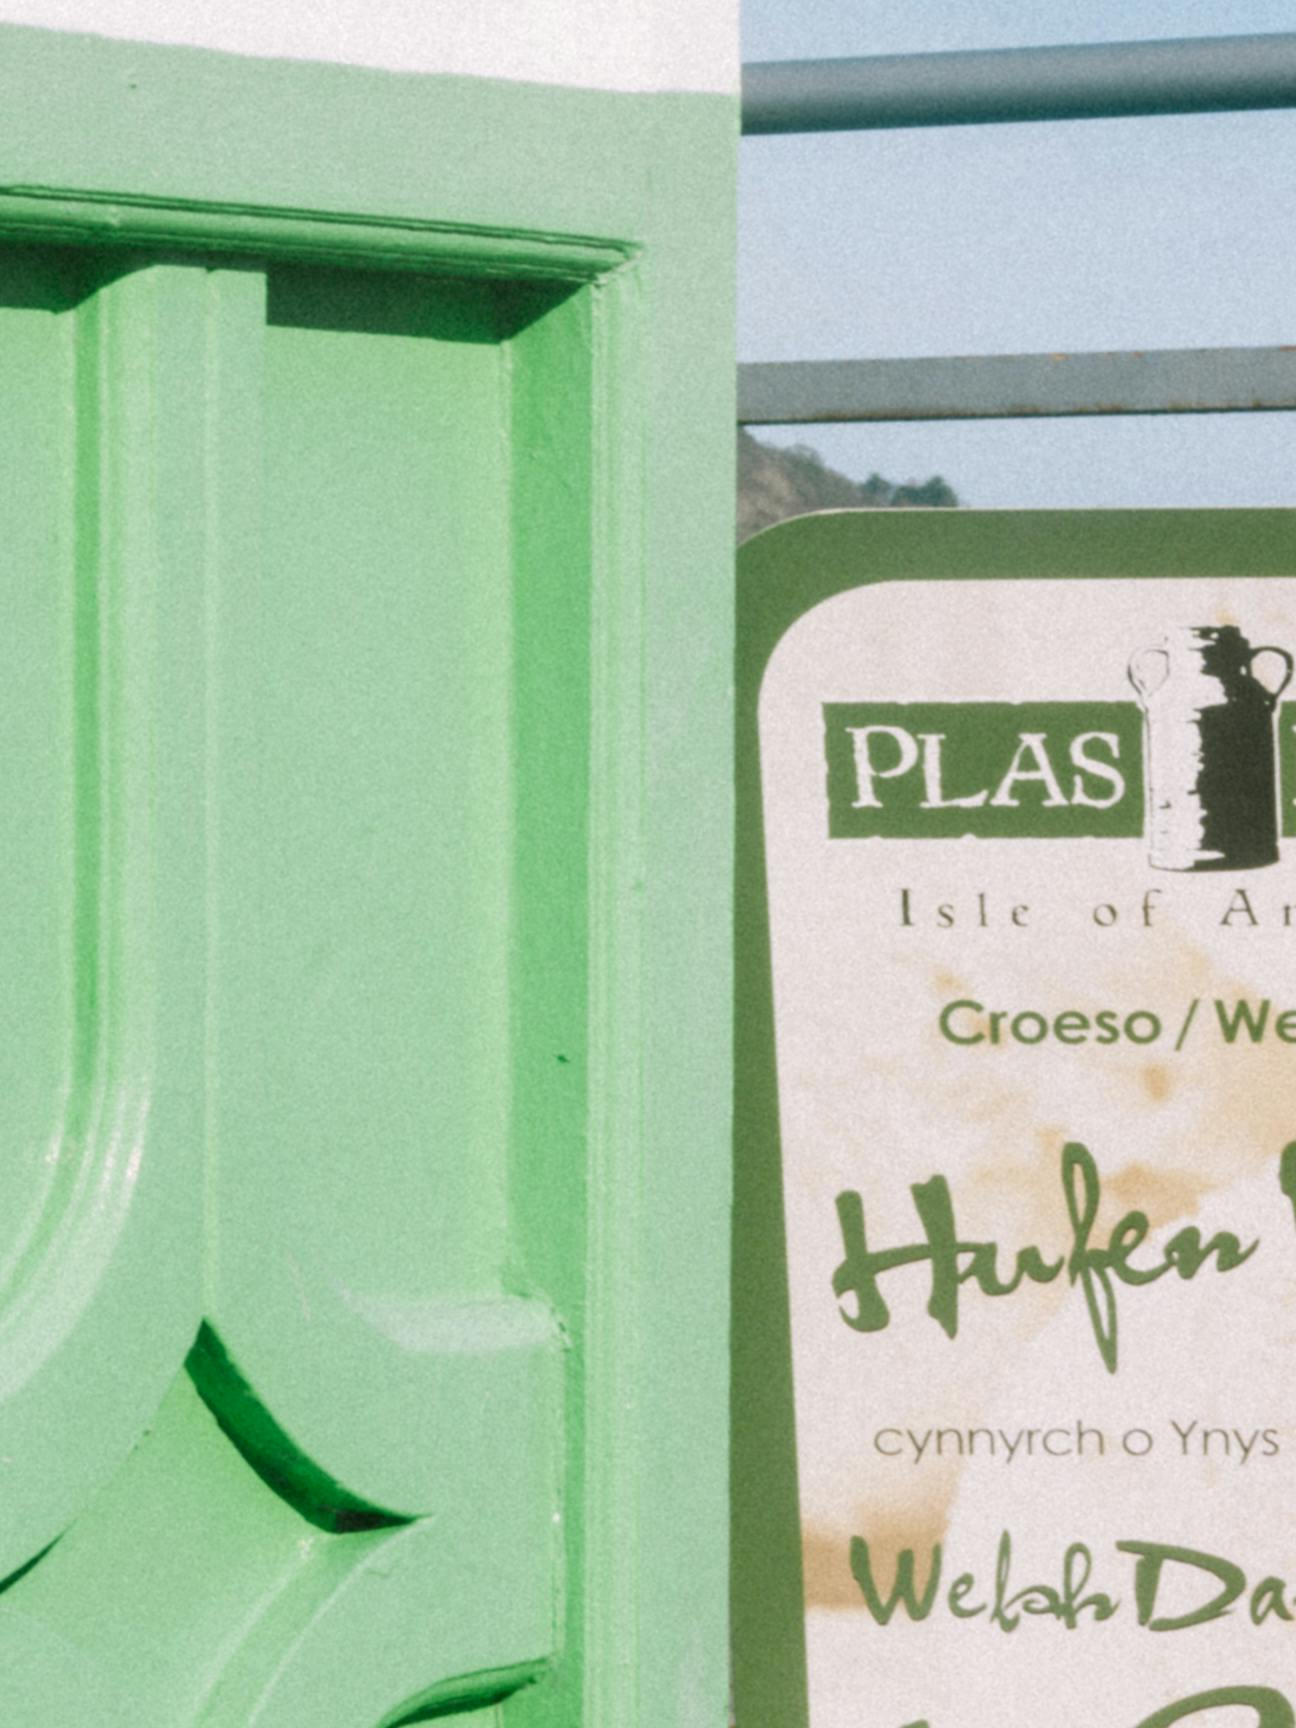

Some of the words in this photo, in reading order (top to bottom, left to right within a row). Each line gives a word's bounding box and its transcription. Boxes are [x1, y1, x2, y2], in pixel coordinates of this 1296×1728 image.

[845, 723, 1127, 810] PLAS
[900, 887, 1032, 928] Isle
[1091, 887, 1163, 928] of
[937, 998, 1163, 1046] Croeso
[831, 1141, 1260, 1375] Hufen
[872, 1419, 1106, 1466] cynnyrch
[1120, 1427, 1155, 1458] o
[1170, 1419, 1281, 1466] Ynys
[848, 1529, 1122, 1633] Welsh
